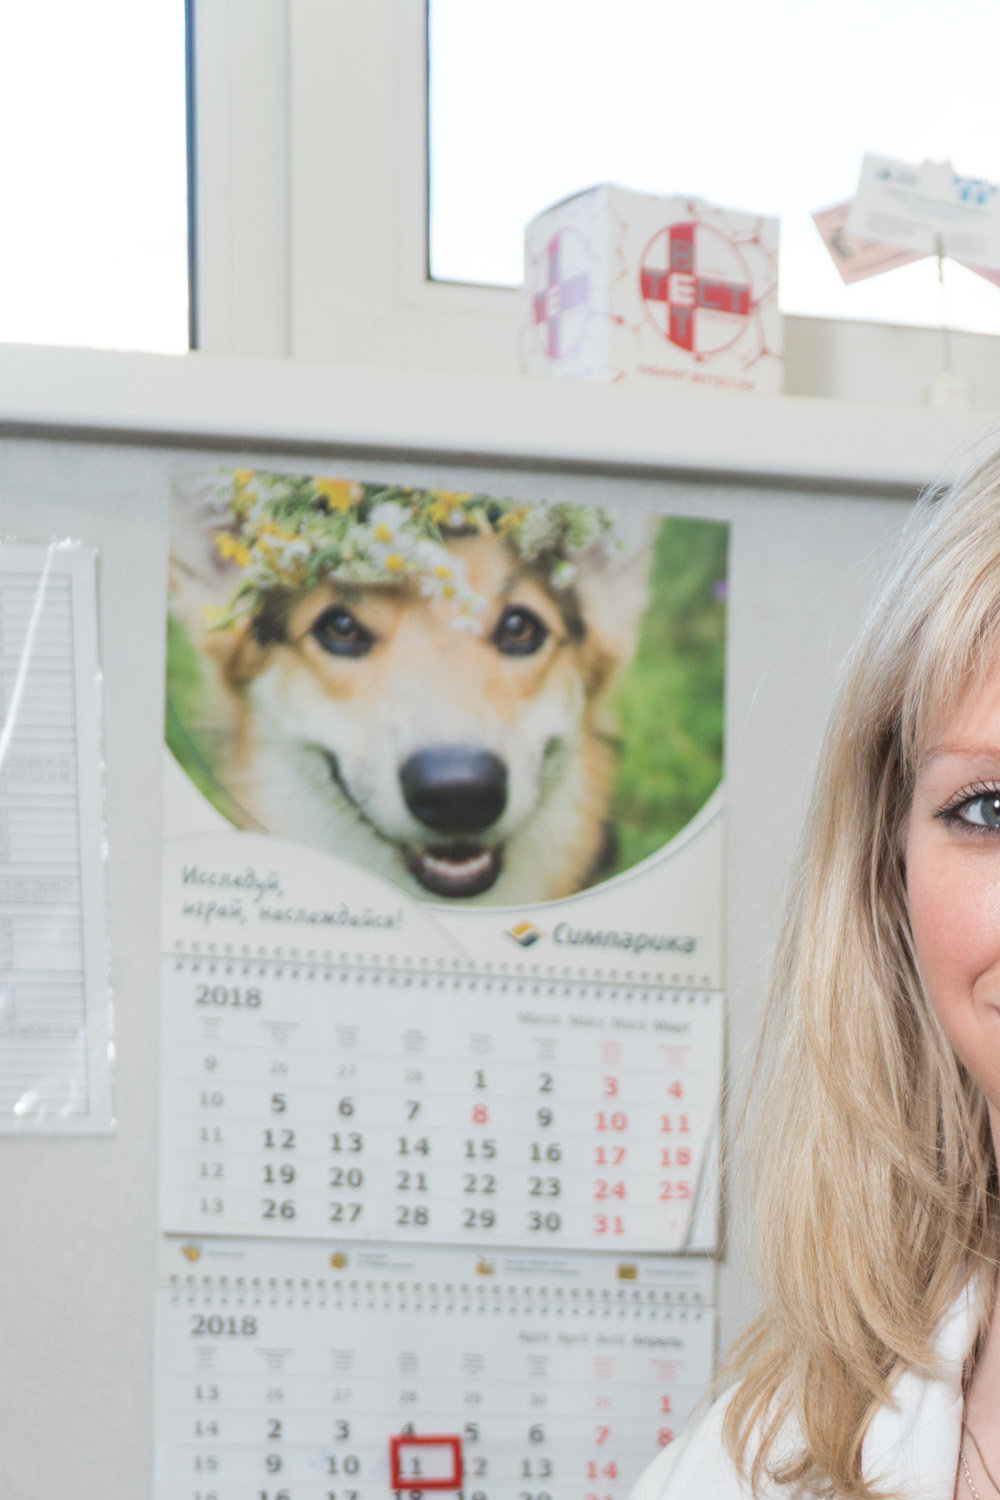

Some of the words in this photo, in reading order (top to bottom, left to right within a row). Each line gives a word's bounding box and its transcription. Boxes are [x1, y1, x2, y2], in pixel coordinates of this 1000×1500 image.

[552, 921, 698, 955] Симпарика
[195, 984, 263, 1010] 2018
[203, 1055, 219, 1073] 9
[475, 1069, 488, 1091] 1
[538, 1072, 554, 1095] 2
[605, 1076, 619, 1098] 3
[667, 1081, 683, 1100] 4
[199, 1090, 226, 1109] 10
[271, 1093, 287, 1115] 5
[337, 1097, 355, 1118] 6
[407, 1100, 421, 1121] 7
[472, 1104, 489, 1125] 8
[537, 1108, 554, 1128] 9
[596, 1111, 628, 1133] 10
[660, 1114, 690, 1135] 11
[199, 1126, 224, 1145] 11
[264, 1129, 296, 1151] 12
[331, 1132, 364, 1154] 13
[398, 1136, 431, 1157] 14
[465, 1139, 498, 1161] 15
[530, 1143, 563, 1164] 16
[595, 1146, 627, 1167] 17
[660, 1147, 692, 1169] 18
[199, 1161, 225, 1181] 12
[264, 1164, 296, 1186] 19
[329, 1167, 365, 1190] 20
[396, 1170, 429, 1193] 21
[463, 1173, 497, 1196] 22
[529, 1176, 562, 1199] 23
[594, 1180, 626, 1201] 24
[659, 1180, 692, 1202] 25
[200, 1197, 226, 1215] 13
[262, 1198, 297, 1221] 26
[329, 1202, 363, 1224] 27
[396, 1206, 430, 1227] 28
[463, 1208, 497, 1230] 29
[529, 1211, 562, 1233] 30
[594, 1214, 625, 1236] 31
[191, 1314, 259, 1338] 2018
[194, 1384, 221, 1402] 13
[660, 1395, 672, 1416] 1
[194, 1419, 220, 1438] 14
[267, 1418, 283, 1441] 2
[335, 1419, 351, 1442] 3
[401, 1420, 417, 1441] 4
[464, 1420, 481, 1444] 5
[527, 1424, 546, 1447] 6
[595, 1426, 610, 1446] 7
[656, 1427, 674, 1449] 8
[193, 1454, 220, 1473] 15
[265, 1453, 284, 1475] 9
[326, 1454, 361, 1476] 10
[521, 1458, 553, 1480] 13
[586, 1460, 619, 1481] 14
